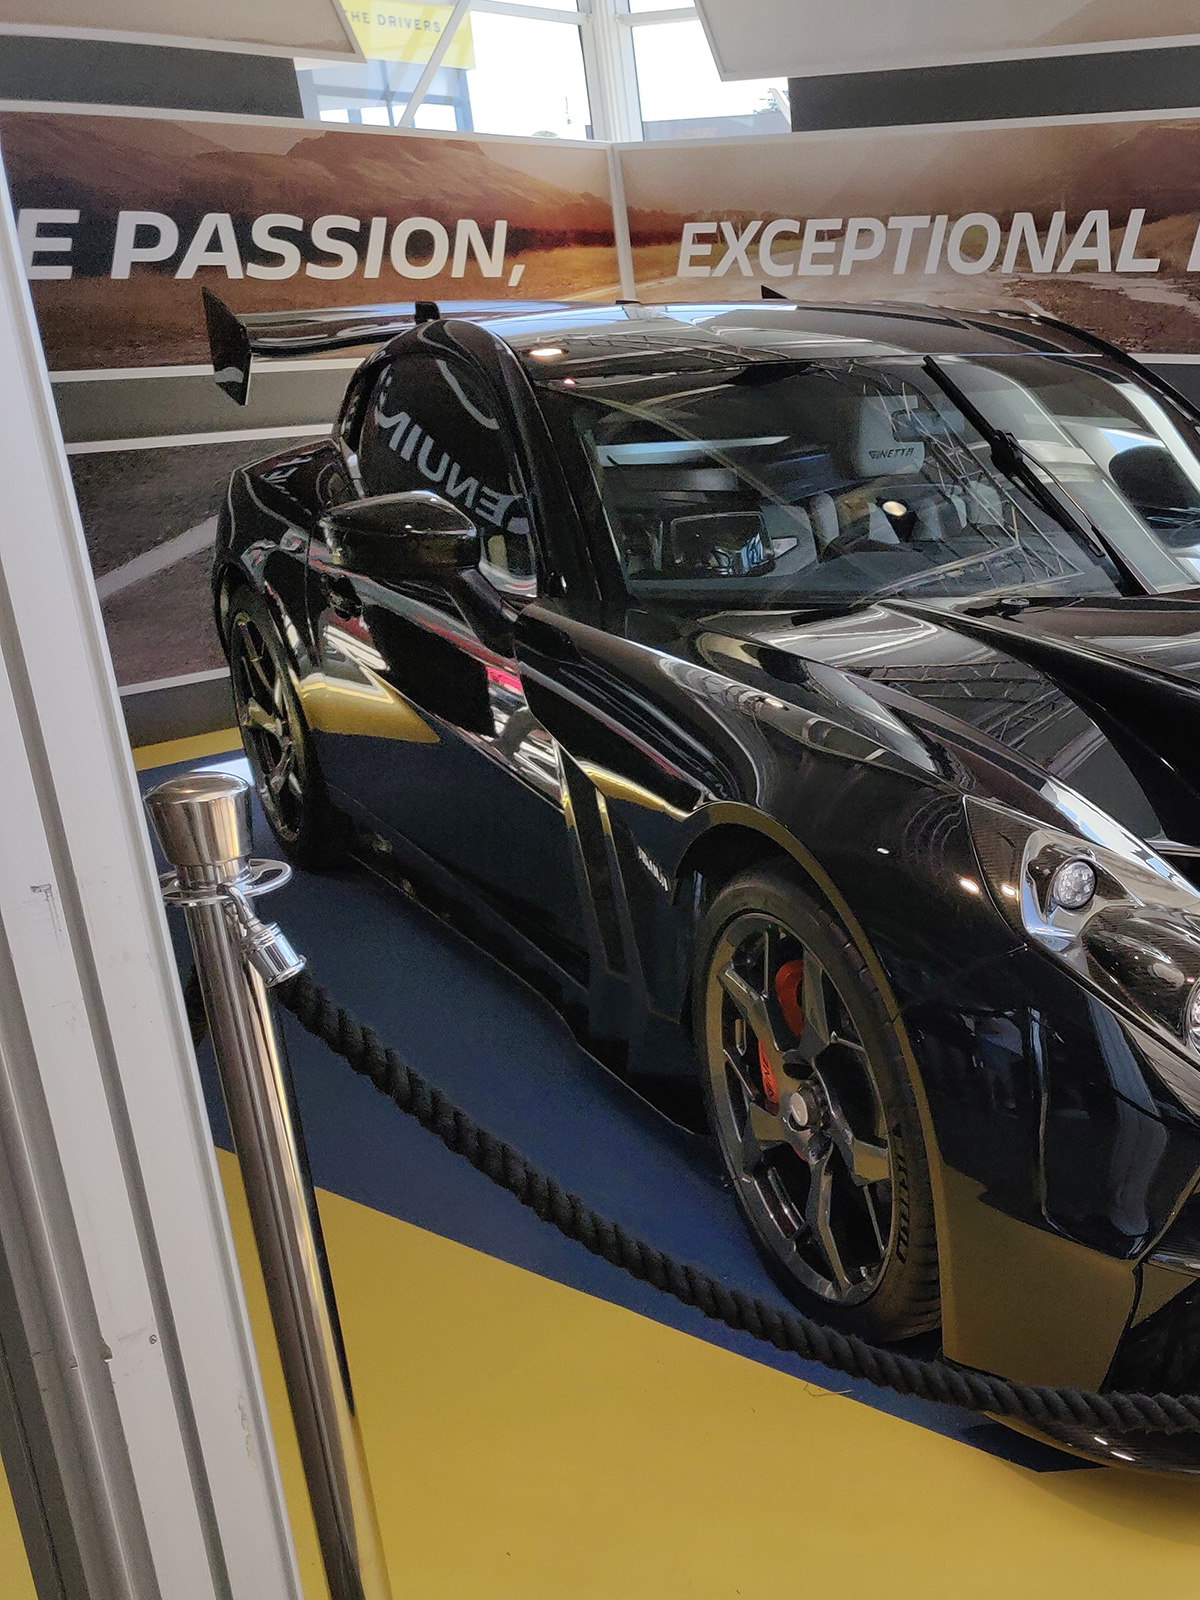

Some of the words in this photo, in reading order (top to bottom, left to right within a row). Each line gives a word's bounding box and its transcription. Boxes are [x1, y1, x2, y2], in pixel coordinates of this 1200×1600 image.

[344, 9, 371, 24] HE
[377, 13, 442, 33] DRIVERS
[110, 210, 526, 287] PASSION,
[677, 207, 1161, 278] EXCEPTIONAL
